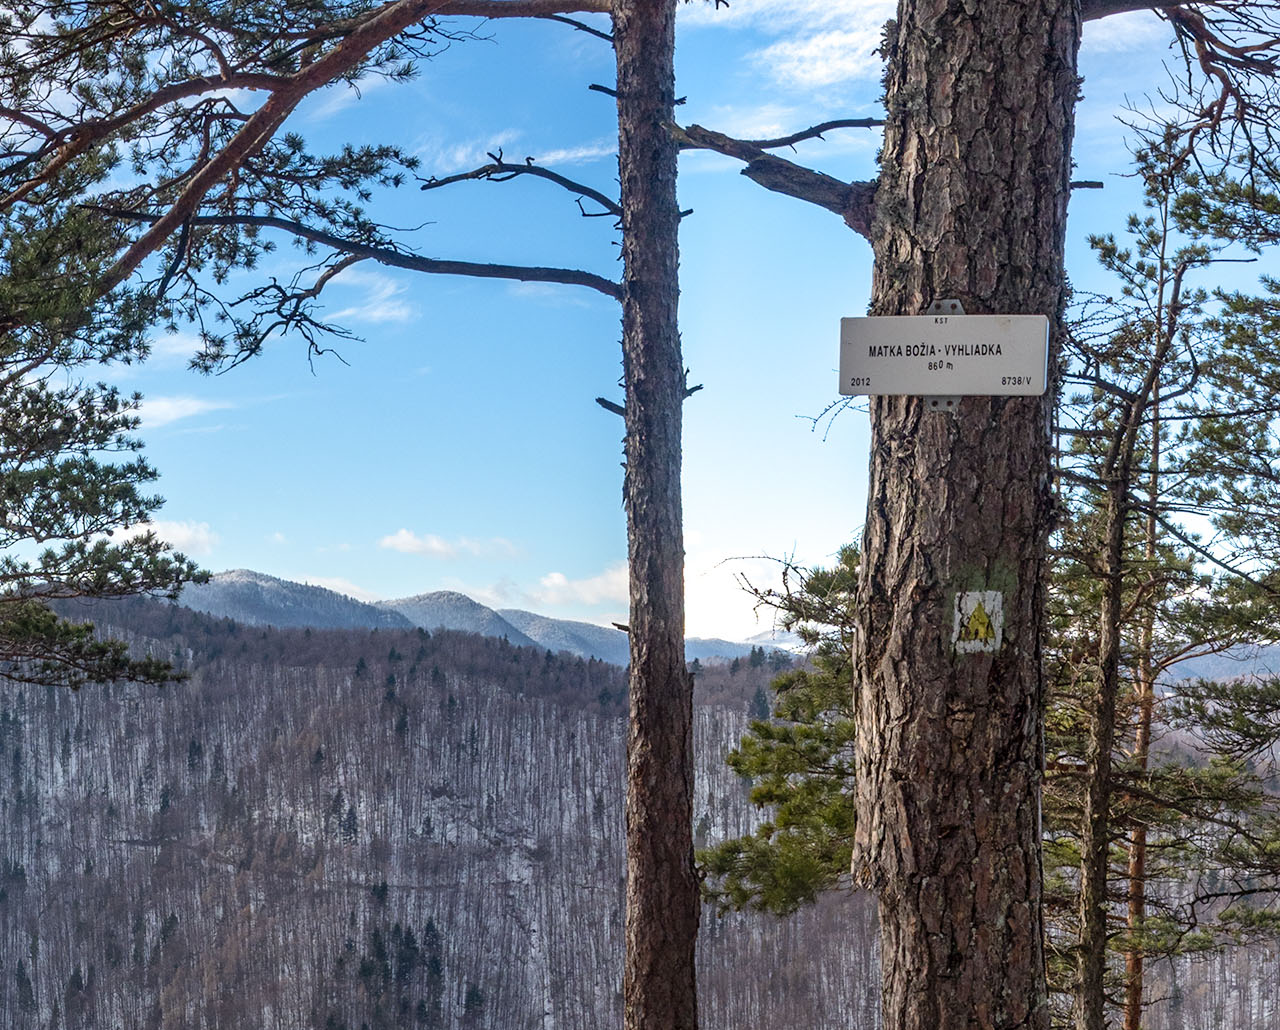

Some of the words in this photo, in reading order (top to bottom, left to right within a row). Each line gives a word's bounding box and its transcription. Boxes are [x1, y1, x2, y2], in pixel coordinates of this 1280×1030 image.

[868, 345, 903, 357] MATKA
[906, 342, 936, 356] BOŽIA
[944, 344, 1002, 356] VYHLIADKA
[928, 360, 944, 371] 860
[946, 362, 954, 370] m
[851, 378, 871, 387] 2012
[1001, 376, 1032, 386] 8738/V
